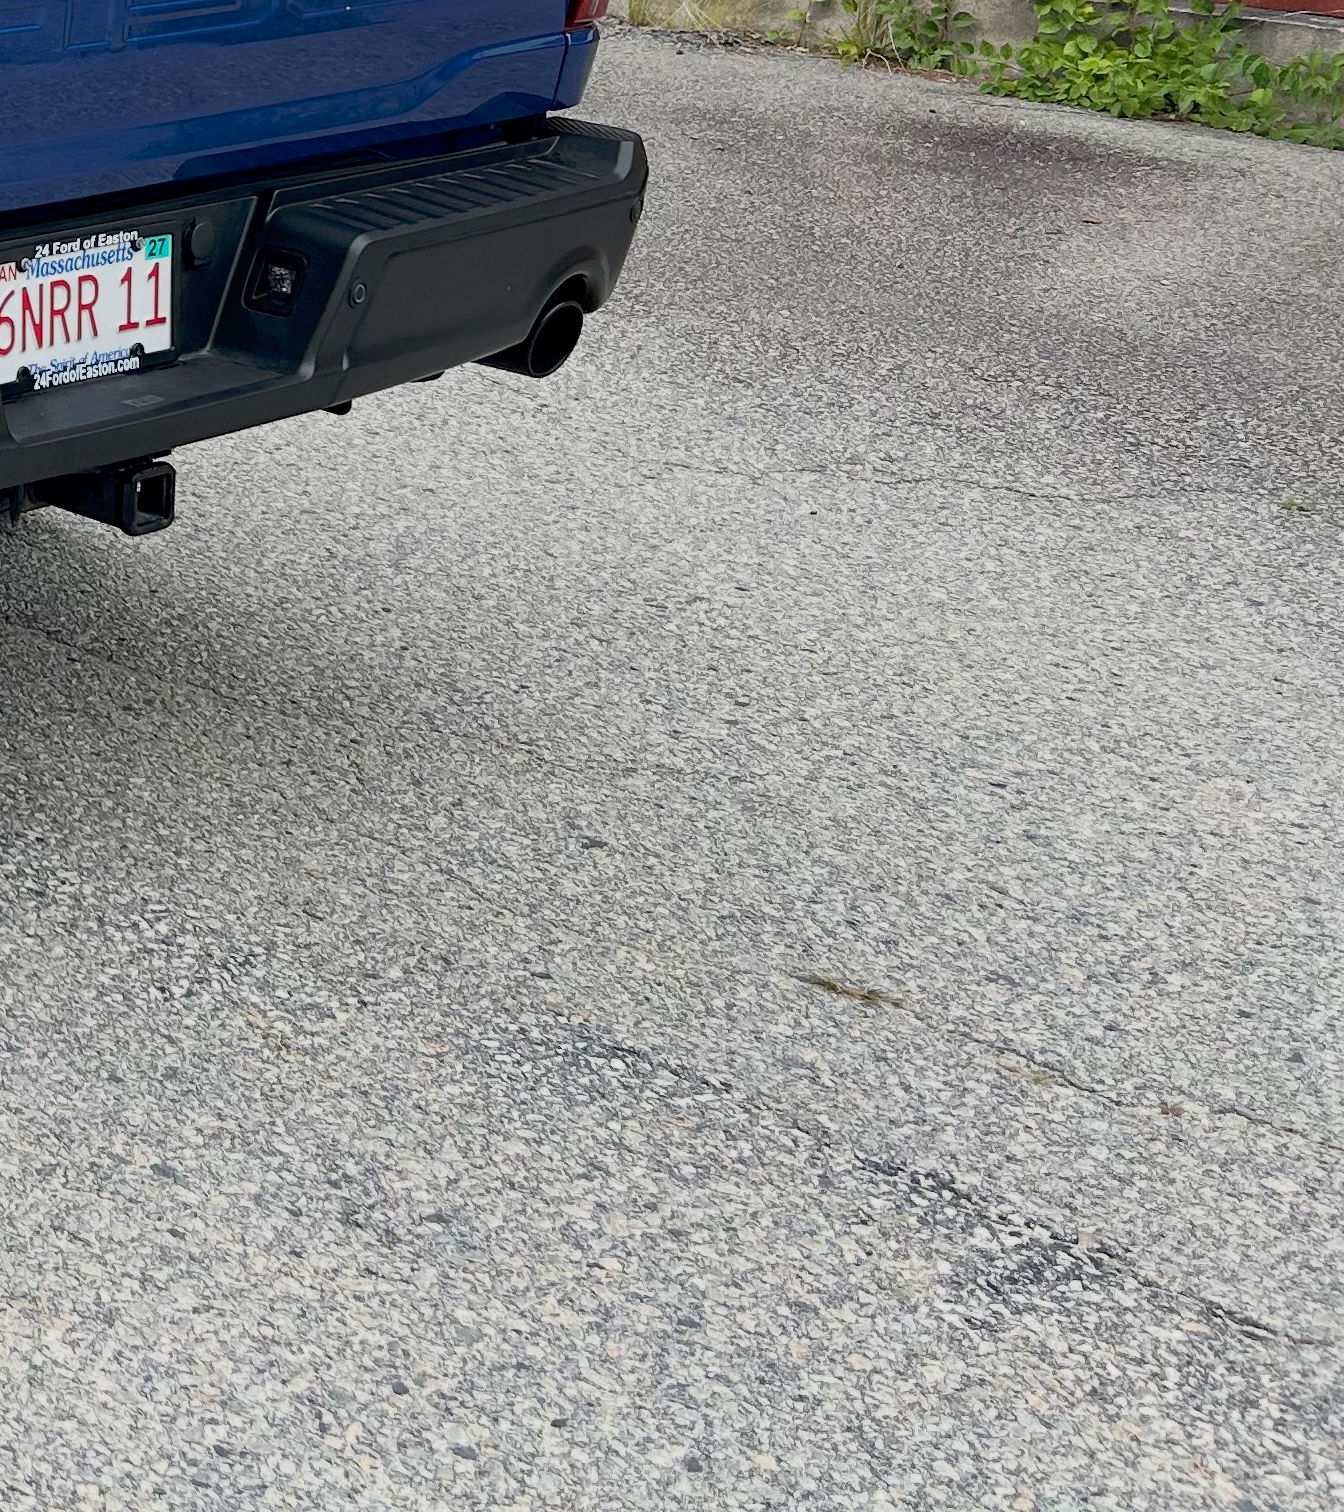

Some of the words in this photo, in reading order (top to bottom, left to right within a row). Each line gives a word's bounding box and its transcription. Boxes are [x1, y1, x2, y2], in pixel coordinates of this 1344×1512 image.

[26, 243, 134, 280] Massachusetts
[34, 245, 50, 259] 24
[52, 238, 80, 256] Ford
[82, 236, 95, 250] of
[97, 230, 139, 247] Easton
[148, 238, 166, 257] 27
[118, 262, 167, 333] 11
[34, 355, 140, 390] 24FordofEaston.com
